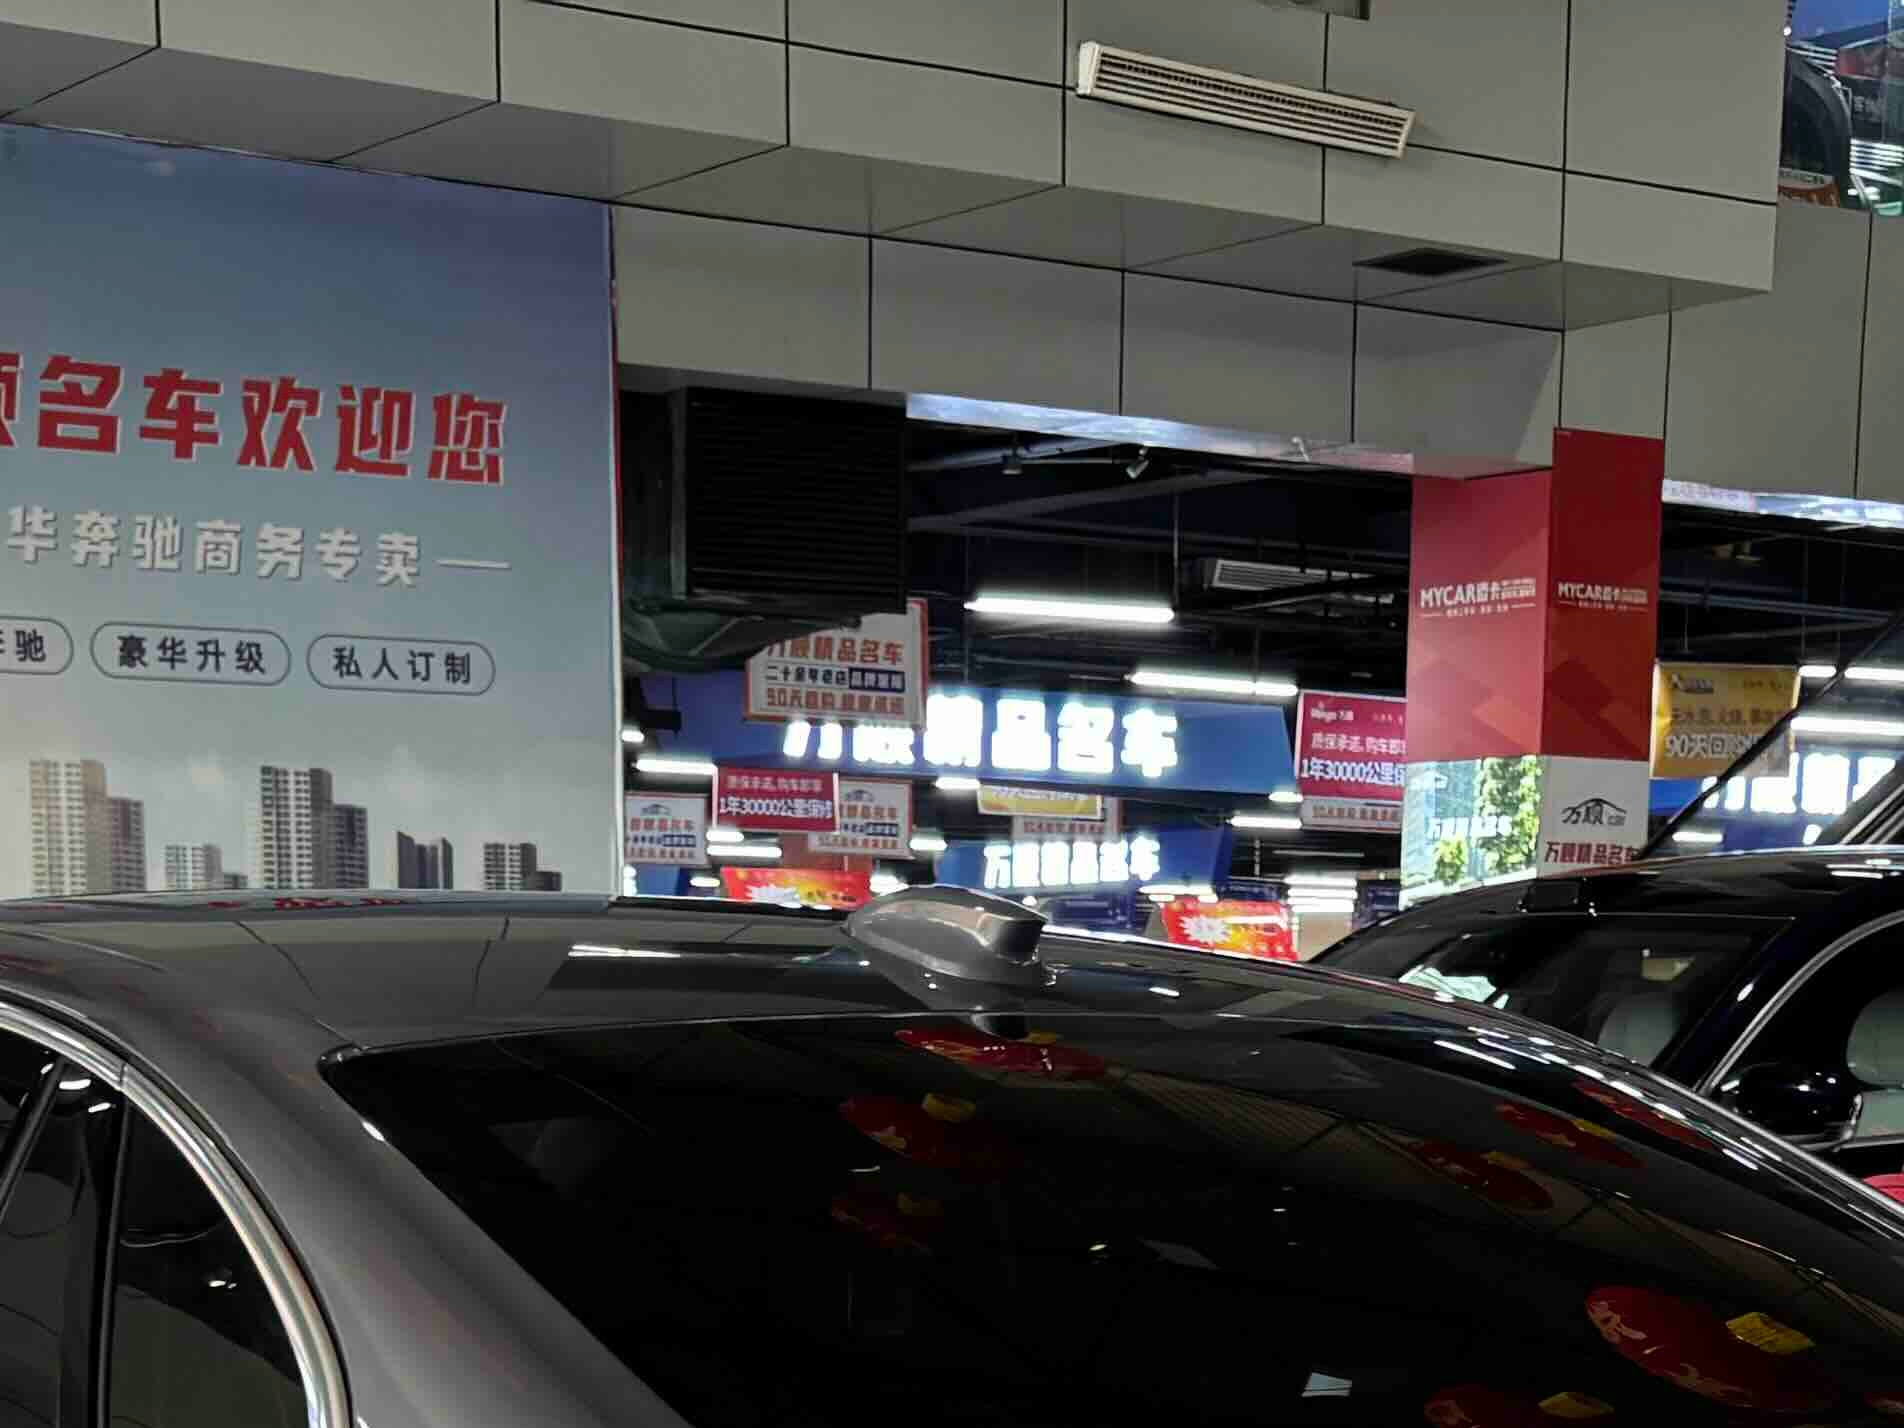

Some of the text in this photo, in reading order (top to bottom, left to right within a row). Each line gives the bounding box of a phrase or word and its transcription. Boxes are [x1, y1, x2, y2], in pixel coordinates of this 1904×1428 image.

[117, 635, 266, 675] 豪华升级
[331, 647, 473, 685] 私人订制
